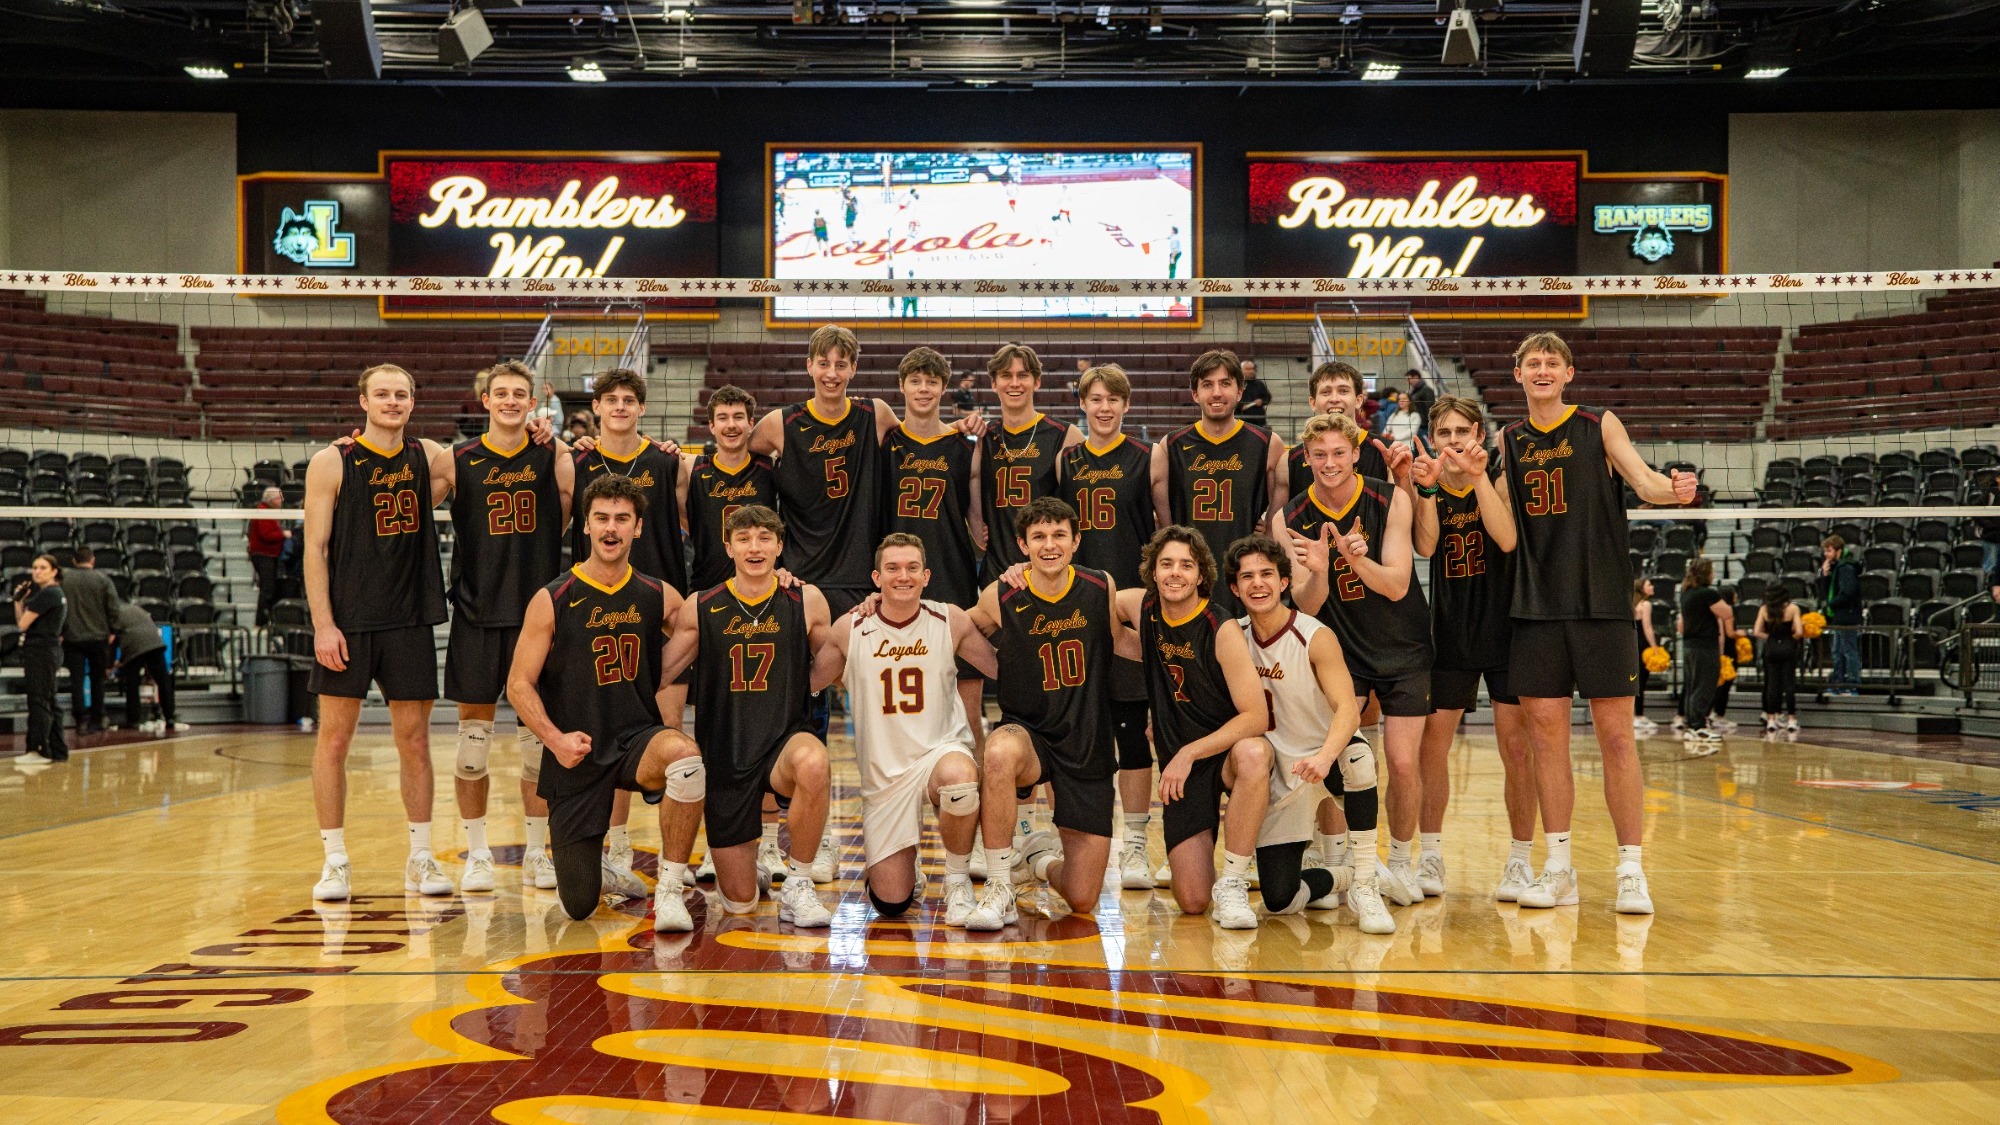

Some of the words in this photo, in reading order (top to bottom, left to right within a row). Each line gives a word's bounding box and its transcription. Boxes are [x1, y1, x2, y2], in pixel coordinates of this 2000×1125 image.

[419, 176, 686, 228] Ramblers
[1278, 176, 1545, 229] Ramblers
[1595, 205, 1710, 230] RAMBLERS
[304, 200, 355, 266] L
[775, 222, 1034, 266] Loyola
[487, 232, 625, 278] Win!
[1347, 233, 1484, 278] Win!
[809, 430, 856, 455] Loyola
[900, 453, 949, 472] Loyola
[993, 442, 1040, 463] Loyola
[1189, 453, 1243, 474] Loyola
[1520, 439, 1573, 463] Loyola
[369, 464, 414, 488] Loyola
[483, 465, 537, 488] Loyola
[632, 469, 655, 487] ola
[709, 481, 757, 501] Loyola
[825, 456, 849, 499] 5
[995, 466, 1032, 507] 15
[1073, 464, 1124, 484] Loyola
[1525, 467, 1568, 516] 31
[374, 490, 420, 536] 29
[487, 490, 537, 536] 28
[898, 477, 946, 519] 27
[1076, 487, 1117, 530] 16
[1193, 478, 1235, 521] 21
[1445, 530, 1486, 578] 22
[1334, 555, 1366, 602] 2
[586, 604, 642, 633] Loyola
[723, 616, 780, 638] Loyola
[1029, 609, 1088, 637] Loyola
[592, 633, 640, 686] 20
[729, 643, 775, 692] 17
[873, 639, 929, 661] Loyola
[1039, 639, 1086, 691] 10
[1255, 661, 1285, 681] yola
[880, 667, 925, 715] 19
